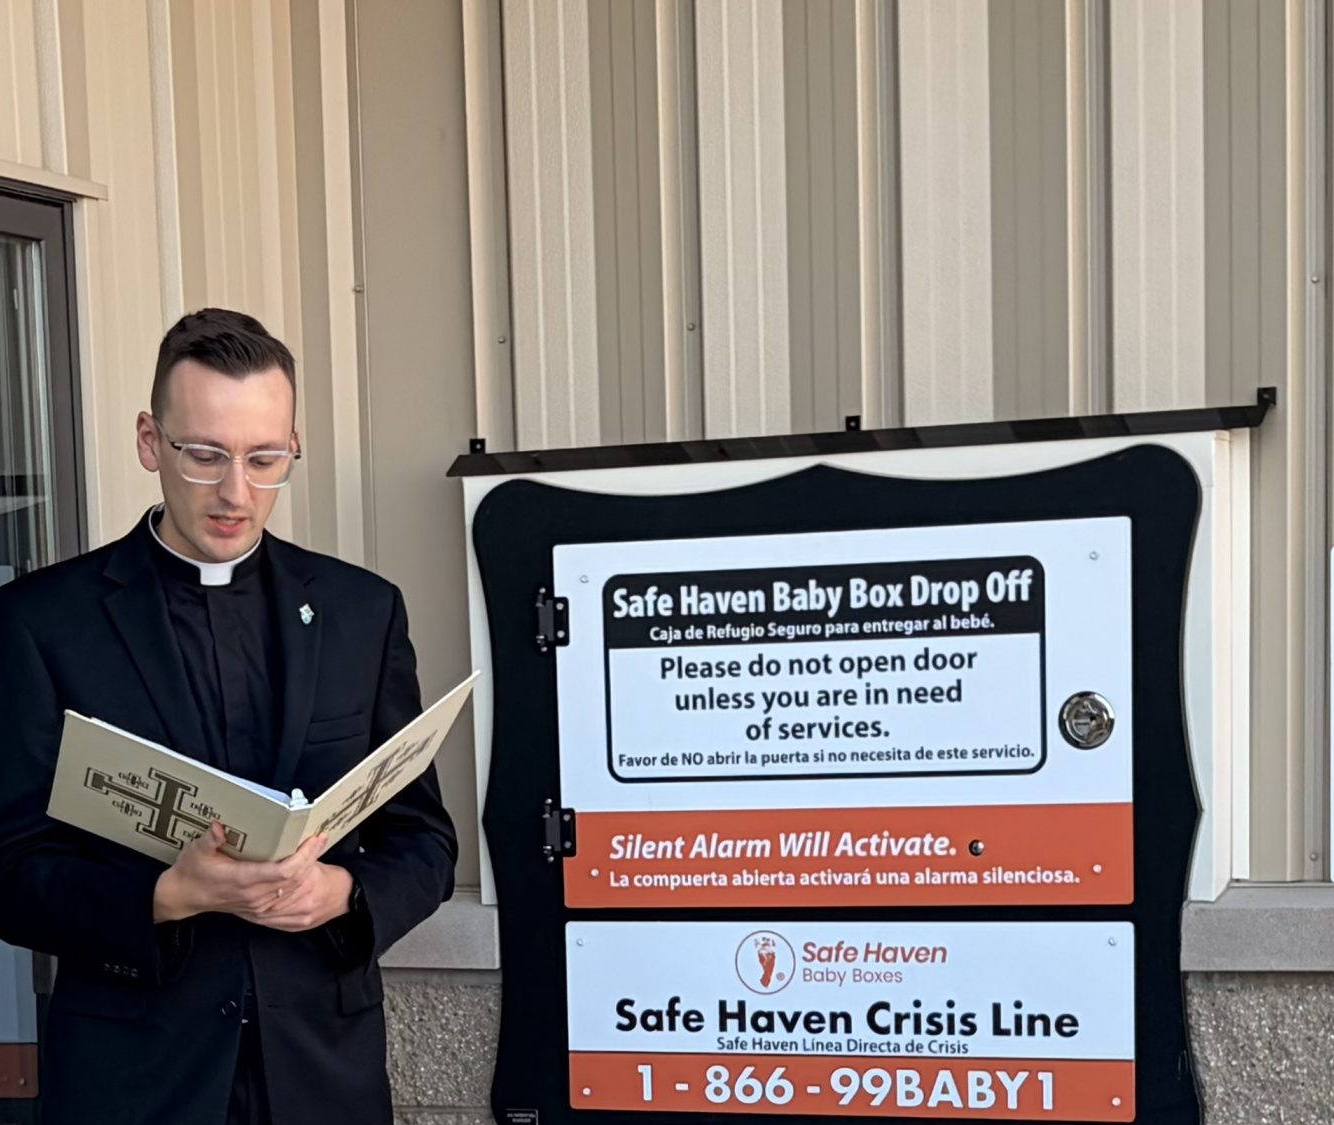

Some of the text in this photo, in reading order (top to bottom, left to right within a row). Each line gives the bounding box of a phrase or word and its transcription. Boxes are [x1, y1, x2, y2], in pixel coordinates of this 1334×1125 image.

[613, 568, 1033, 617] Safe Haven Baby Box Drop Off
[649, 613, 994, 643] Caja de Refugio Seguro para entregar al bebé.
[660, 648, 977, 679] Please do not open door
[675, 679, 961, 712] unless you are in need
[745, 715, 889, 740] of services.
[618, 744, 1034, 766] Favor de NO abrir la puerta si no necesita de este servicio.
[609, 830, 956, 859] Silent Alarm Will Activate.
[609, 866, 1080, 890] La compuerta abierta activará una alarma silenciosa.
[801, 940, 947, 963] Safe Haven
[802, 967, 902, 987] Baby Boxes
[615, 996, 1079, 1037] Safe Haven Crisis Line
[716, 1036, 968, 1054] Safe Haven Línea Directa de Crisis
[637, 1064, 652, 1100] 1
[704, 1065, 793, 1104] 866
[830, 1067, 1052, 1109] 99BABY1
